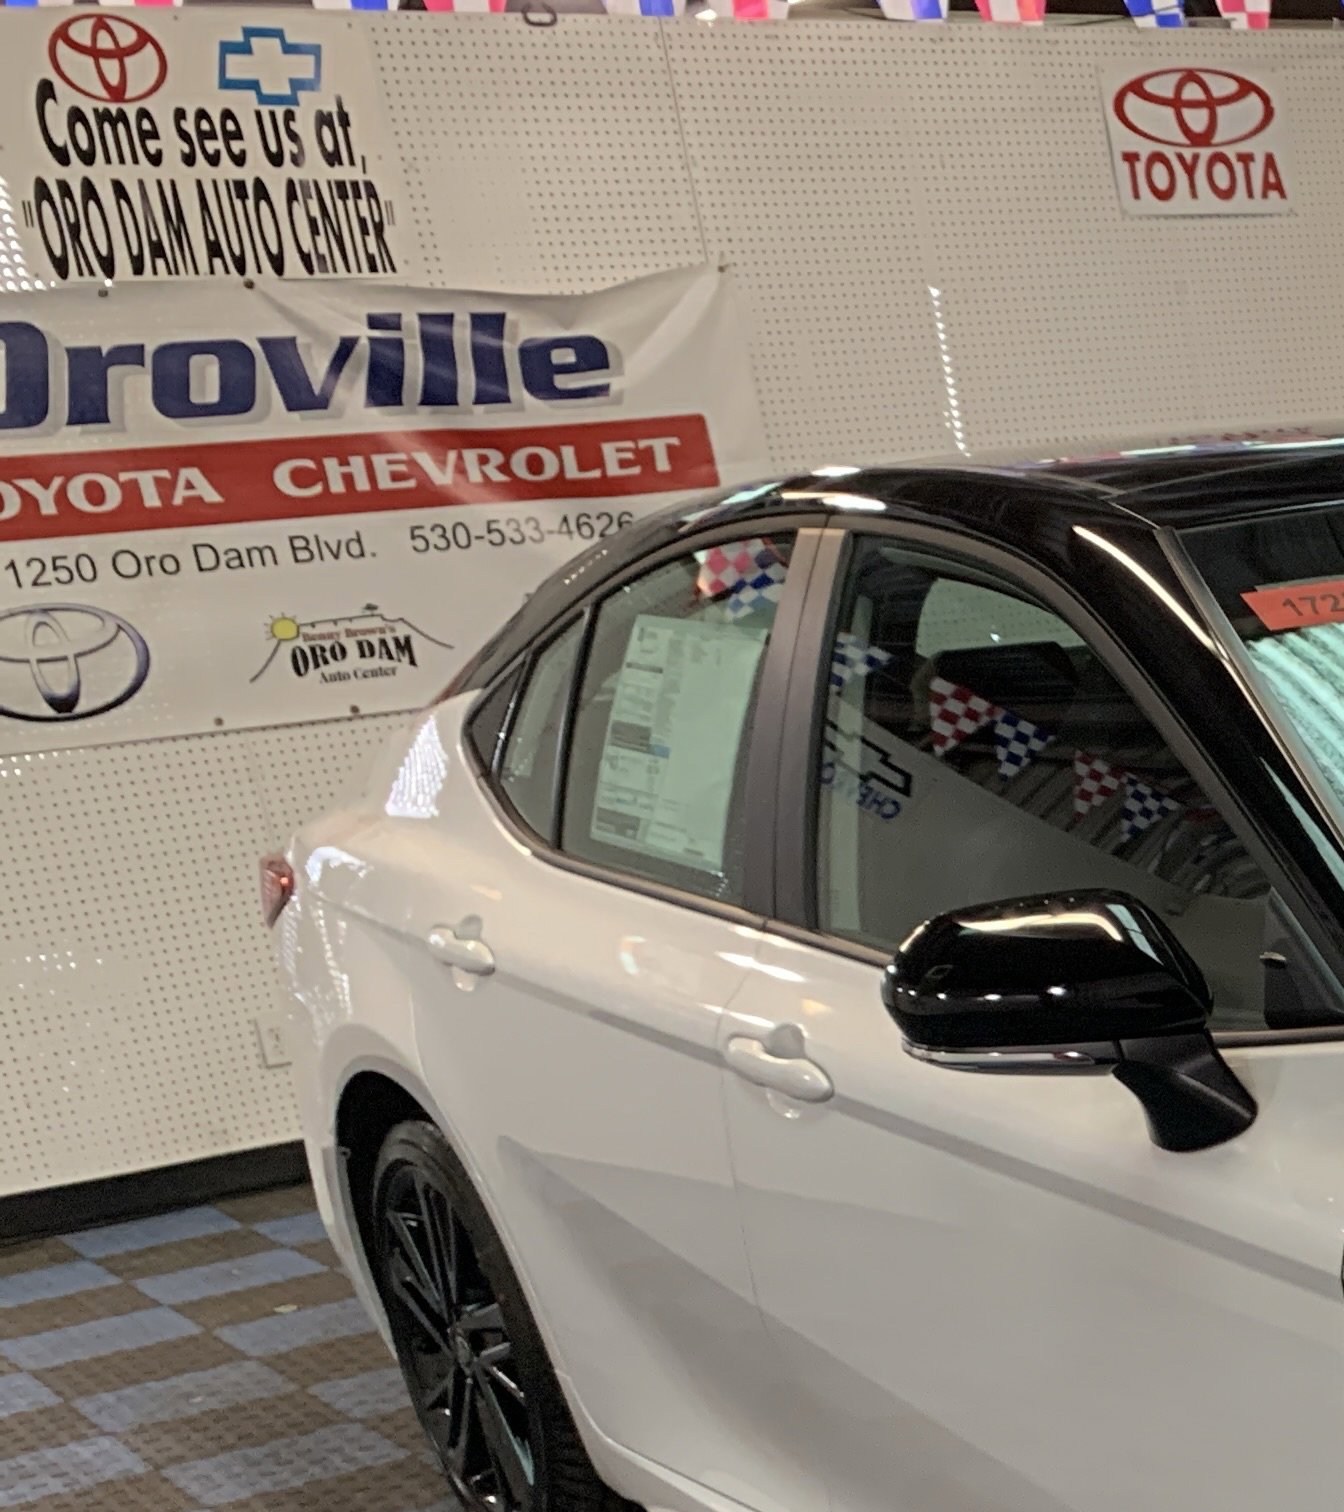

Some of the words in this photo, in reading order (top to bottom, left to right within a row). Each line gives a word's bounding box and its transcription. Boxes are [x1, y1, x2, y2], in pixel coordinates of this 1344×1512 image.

[35, 78, 163, 167] Come
[174, 107, 247, 168] see
[255, 107, 306, 168] us
[1121, 151, 1288, 201] TOYOTA
[111, 178, 200, 277] DAM
[196, 176, 286, 278] AUTO
[272, 436, 680, 499] CHEVROLET
[4, 552, 99, 590] 1250
[111, 547, 181, 581] Oro
[193, 540, 279, 574] Dam
[288, 530, 377, 566] Blvd.
[409, 510, 635, 553] 530-533-4626
[291, 641, 348, 678] ORO
[356, 635, 418, 669] DAM
[320, 669, 351, 685] Auto
[354, 664, 398, 681] Center
